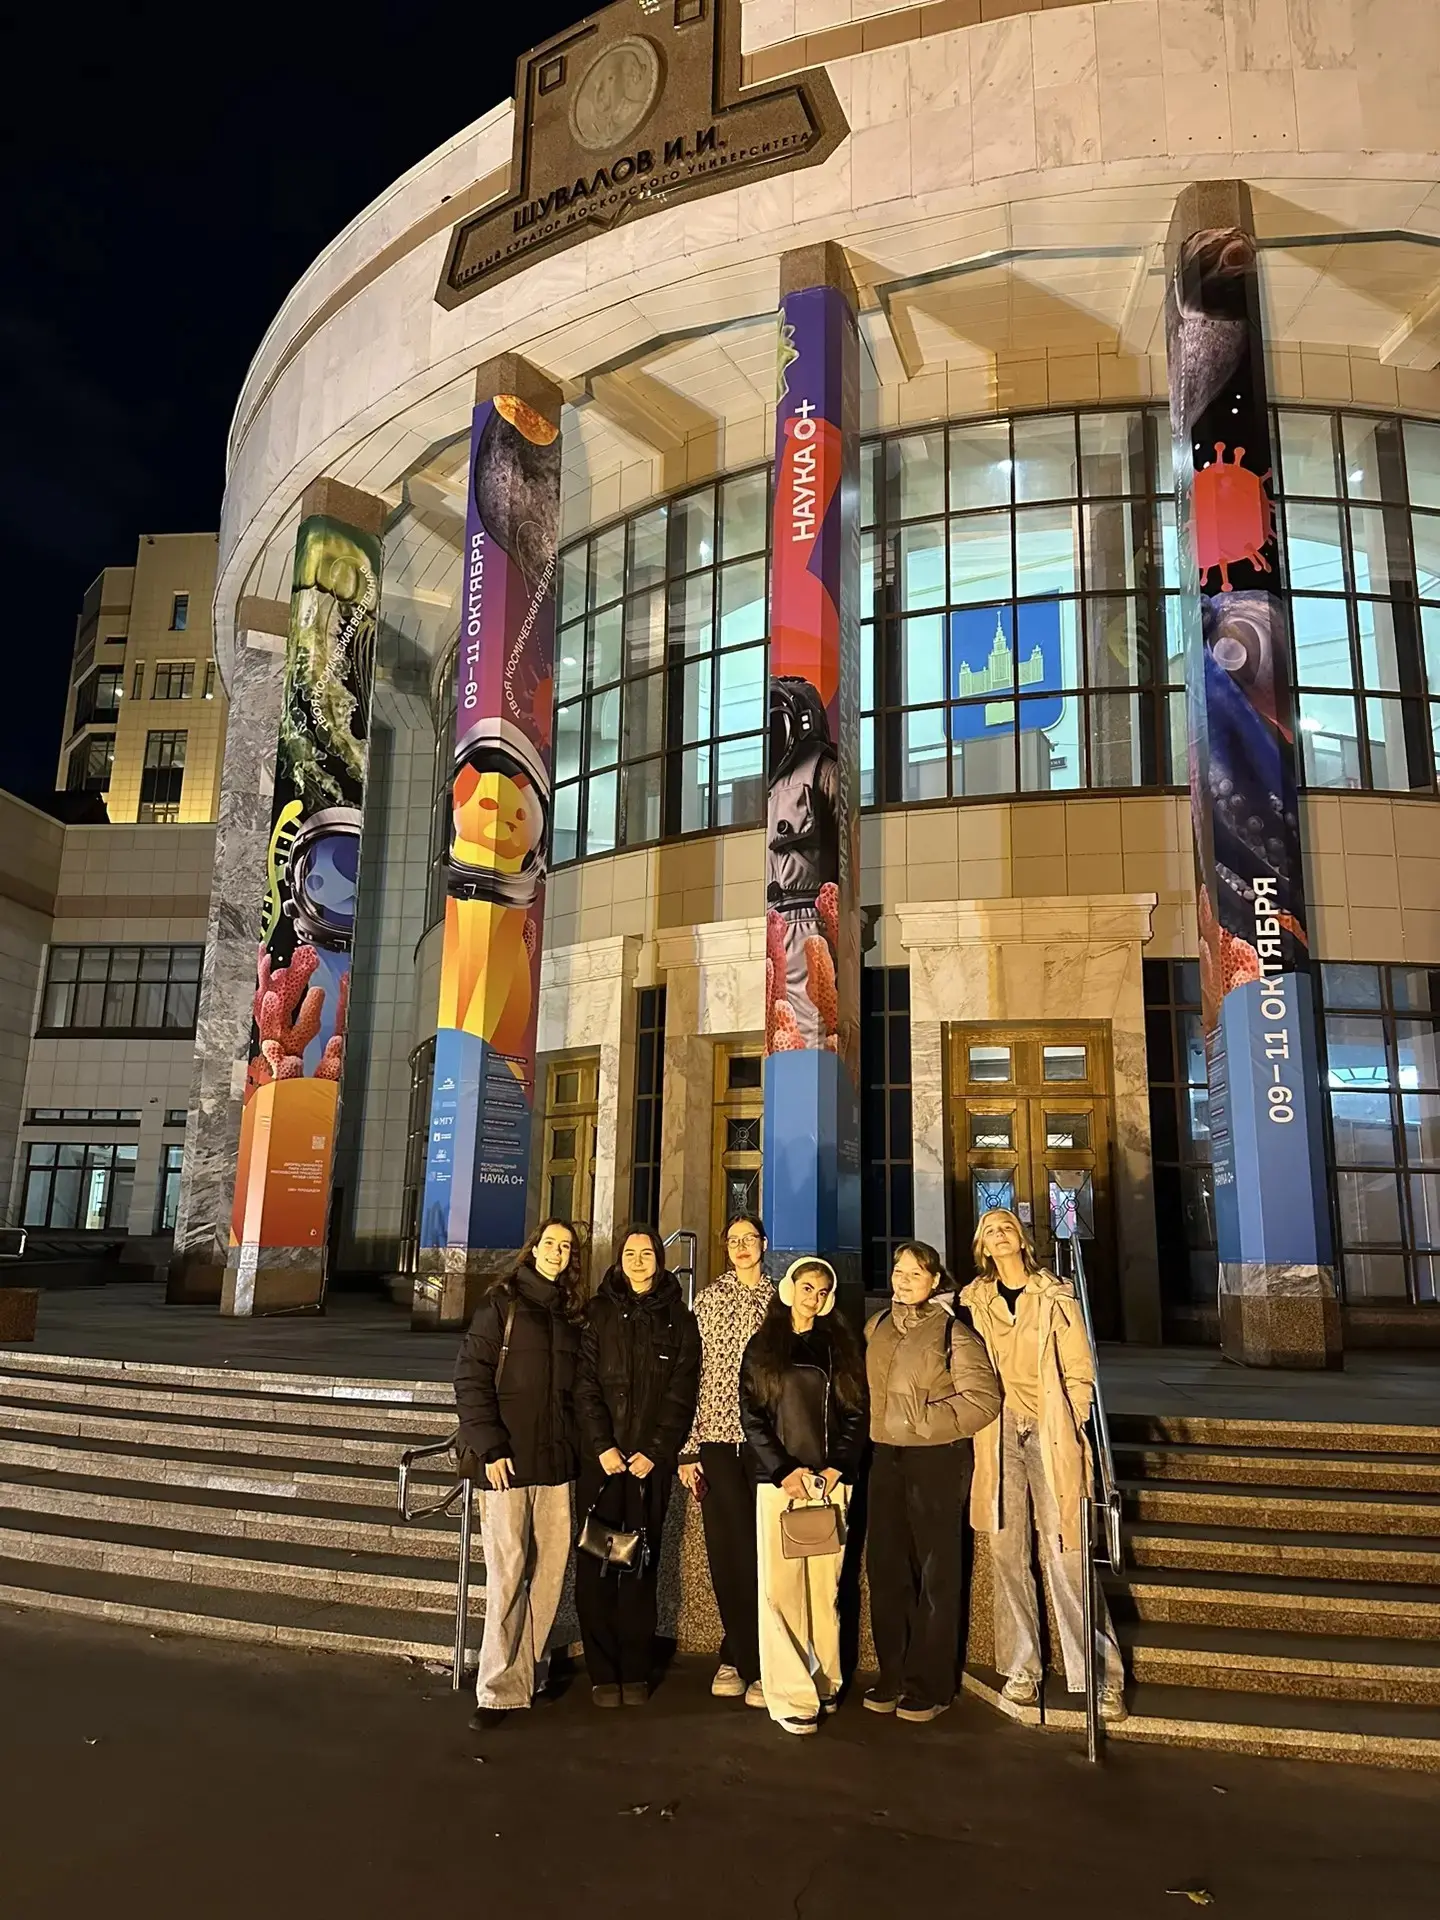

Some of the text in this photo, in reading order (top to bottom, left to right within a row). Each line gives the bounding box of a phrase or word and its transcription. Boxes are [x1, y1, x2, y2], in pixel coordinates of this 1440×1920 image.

[457, 131, 810, 282] ПЕРВЫЙ КУРАТОР МОСКОВСКОГО УНИВЕРСИТЕТА
[513, 150, 653, 233] ШУВАЛОВ
[792, 443, 816, 542] НАУКА
[467, 531, 485, 637] ОКТЯБРЯ
[311, 565, 376, 732] ТВОЯ КОСМИЧЕСКАЯ ВСЕЛЕННАЯ
[505, 600, 540, 678] КОСМИЧЕСКАЯ
[504, 681, 520, 719] ТВОЯ
[1253, 877, 1286, 1020] ОКТЯБРЯ
[479, 1172, 510, 1185] НАУКА
